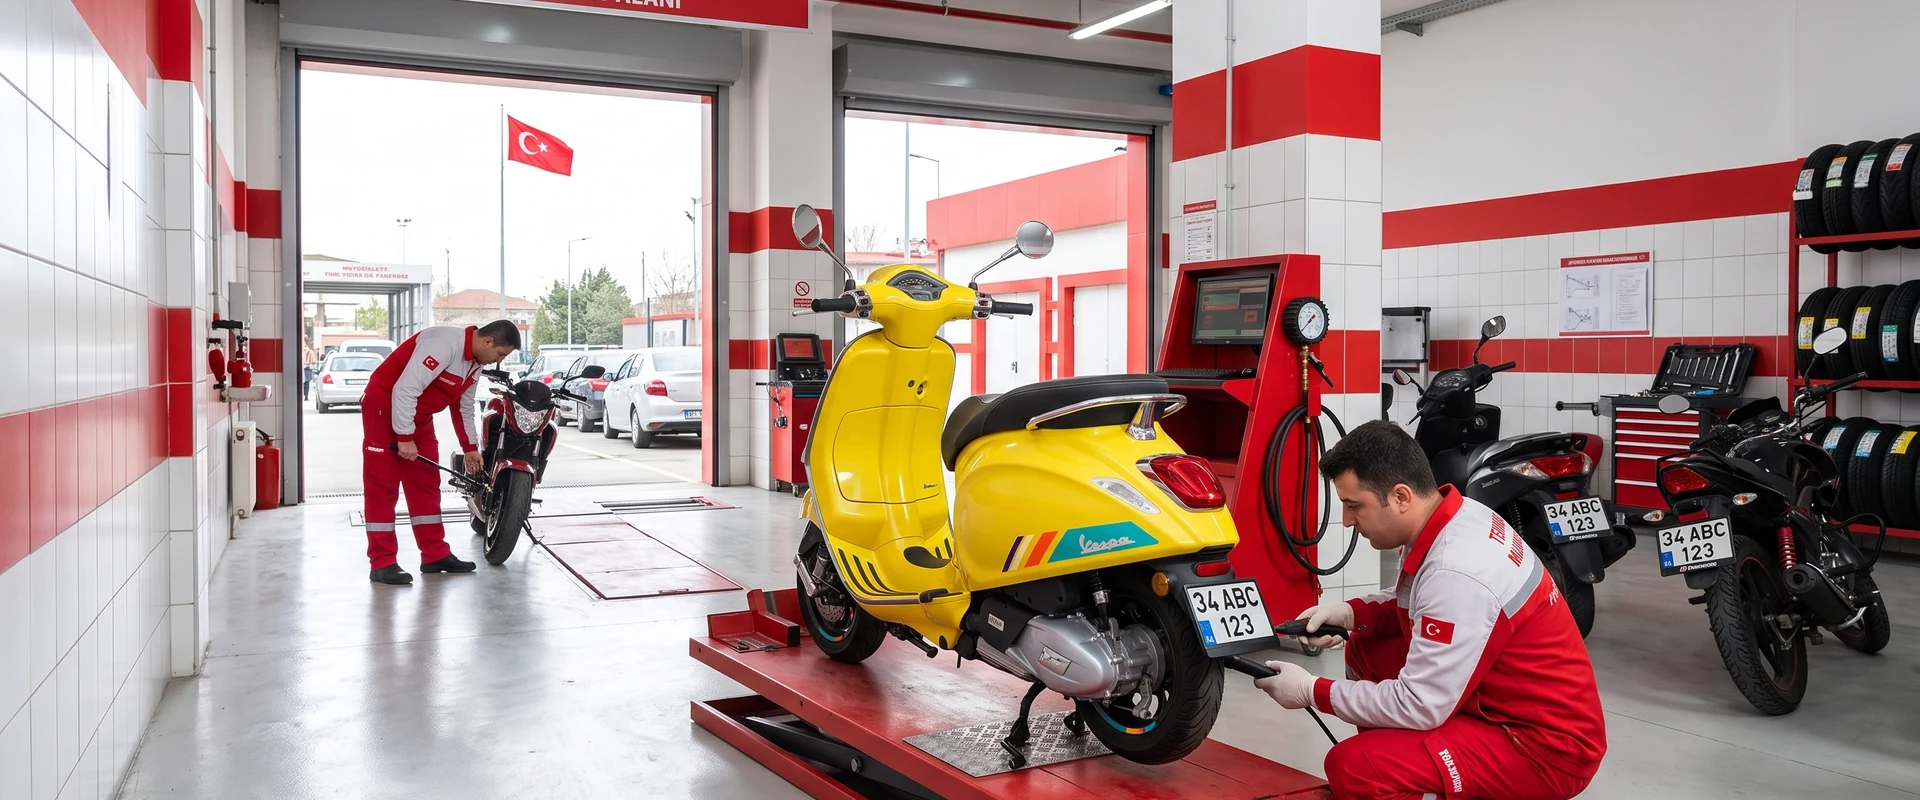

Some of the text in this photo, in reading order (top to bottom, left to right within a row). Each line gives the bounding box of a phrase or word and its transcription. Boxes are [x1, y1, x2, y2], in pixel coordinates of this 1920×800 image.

[615, 0, 681, 9] ANI
[1548, 500, 1600, 518] 34 ABC
[1567, 517, 1595, 532] 123
[1662, 522, 1726, 546] 34 ABC
[1079, 534, 1136, 554] Vespa
[1682, 543, 1714, 562] 123
[1193, 586, 1259, 613] 34 ABC
[1220, 614, 1254, 638] 123
